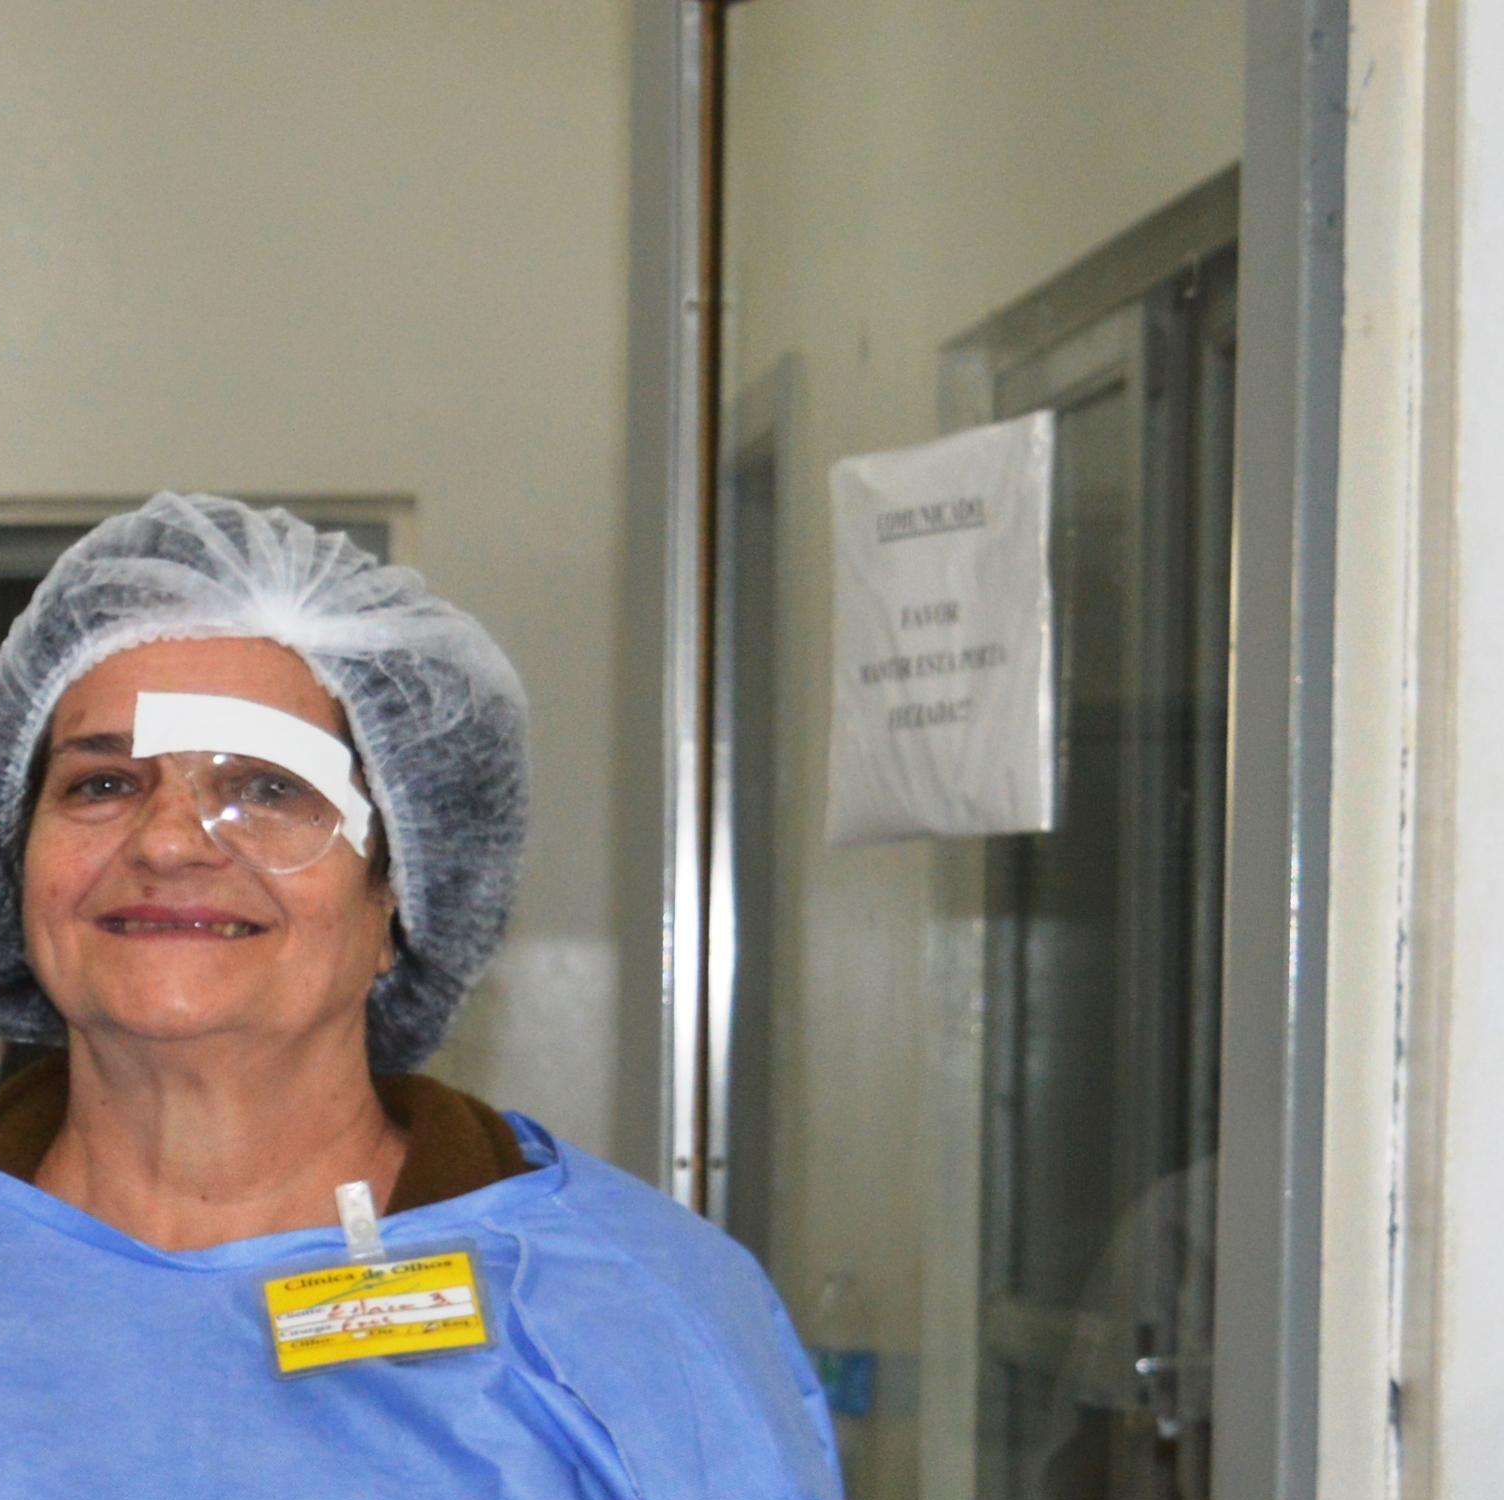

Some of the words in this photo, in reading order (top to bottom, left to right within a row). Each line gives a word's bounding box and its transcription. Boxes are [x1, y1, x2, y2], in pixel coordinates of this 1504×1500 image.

[284, 1272, 355, 1293] Clínica
[363, 1267, 386, 1281] de
[391, 1259, 454, 1275] Olhos
